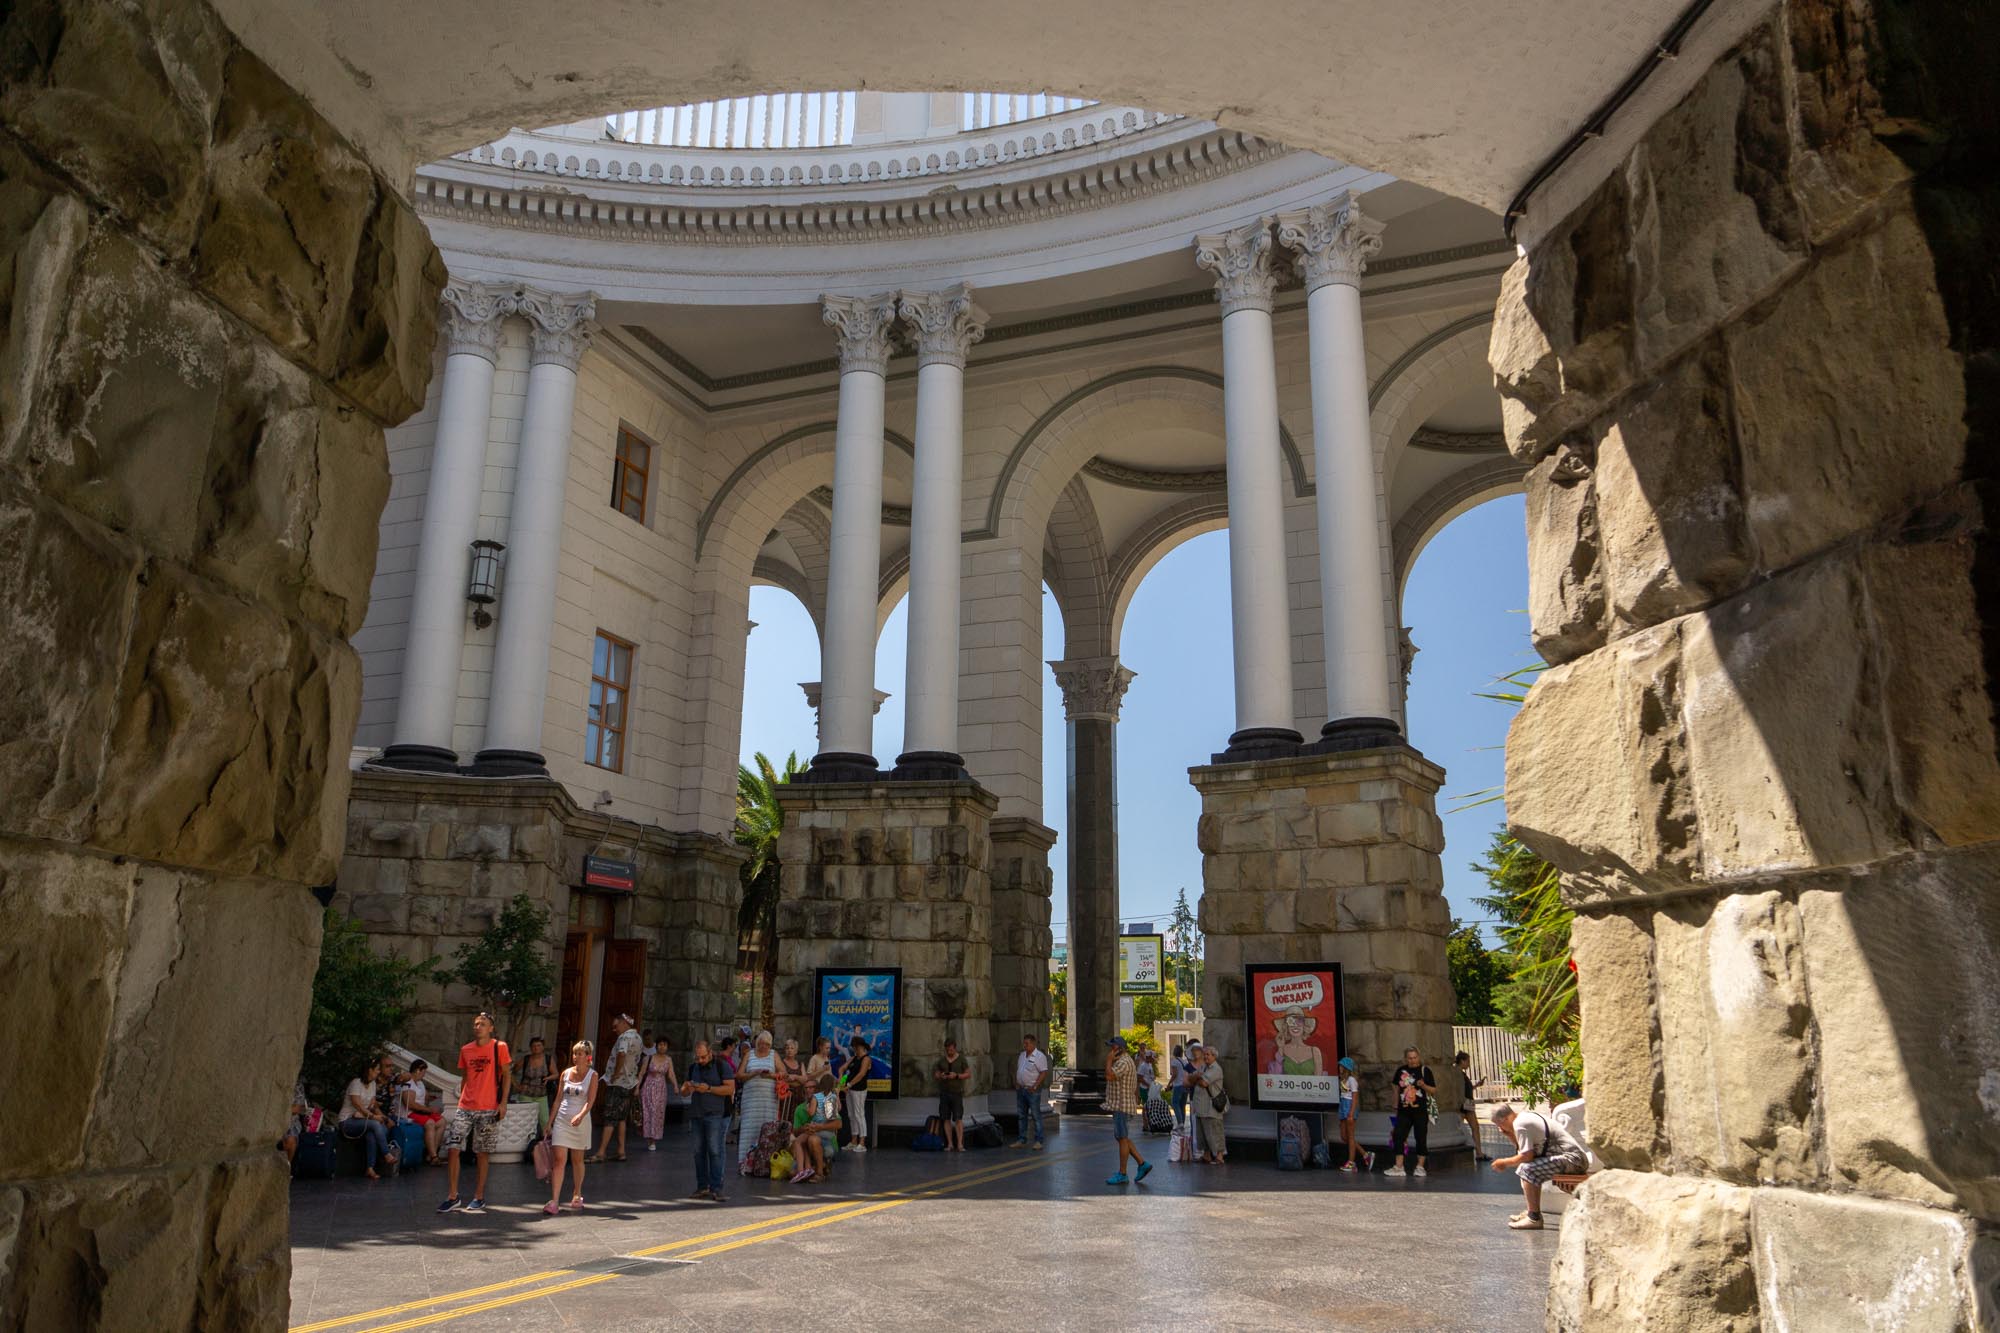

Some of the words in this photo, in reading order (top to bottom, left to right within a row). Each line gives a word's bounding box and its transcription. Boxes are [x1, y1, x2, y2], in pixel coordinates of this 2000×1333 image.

[1271, 980, 1313, 994] ЗАКАЖИТЕ
[1272, 991, 1314, 1005] ПОЕЗДКУ
[826, 1005, 889, 1014] ОКЕАНАРИУМ
[1278, 1080, 1330, 1091] 290-00-00
